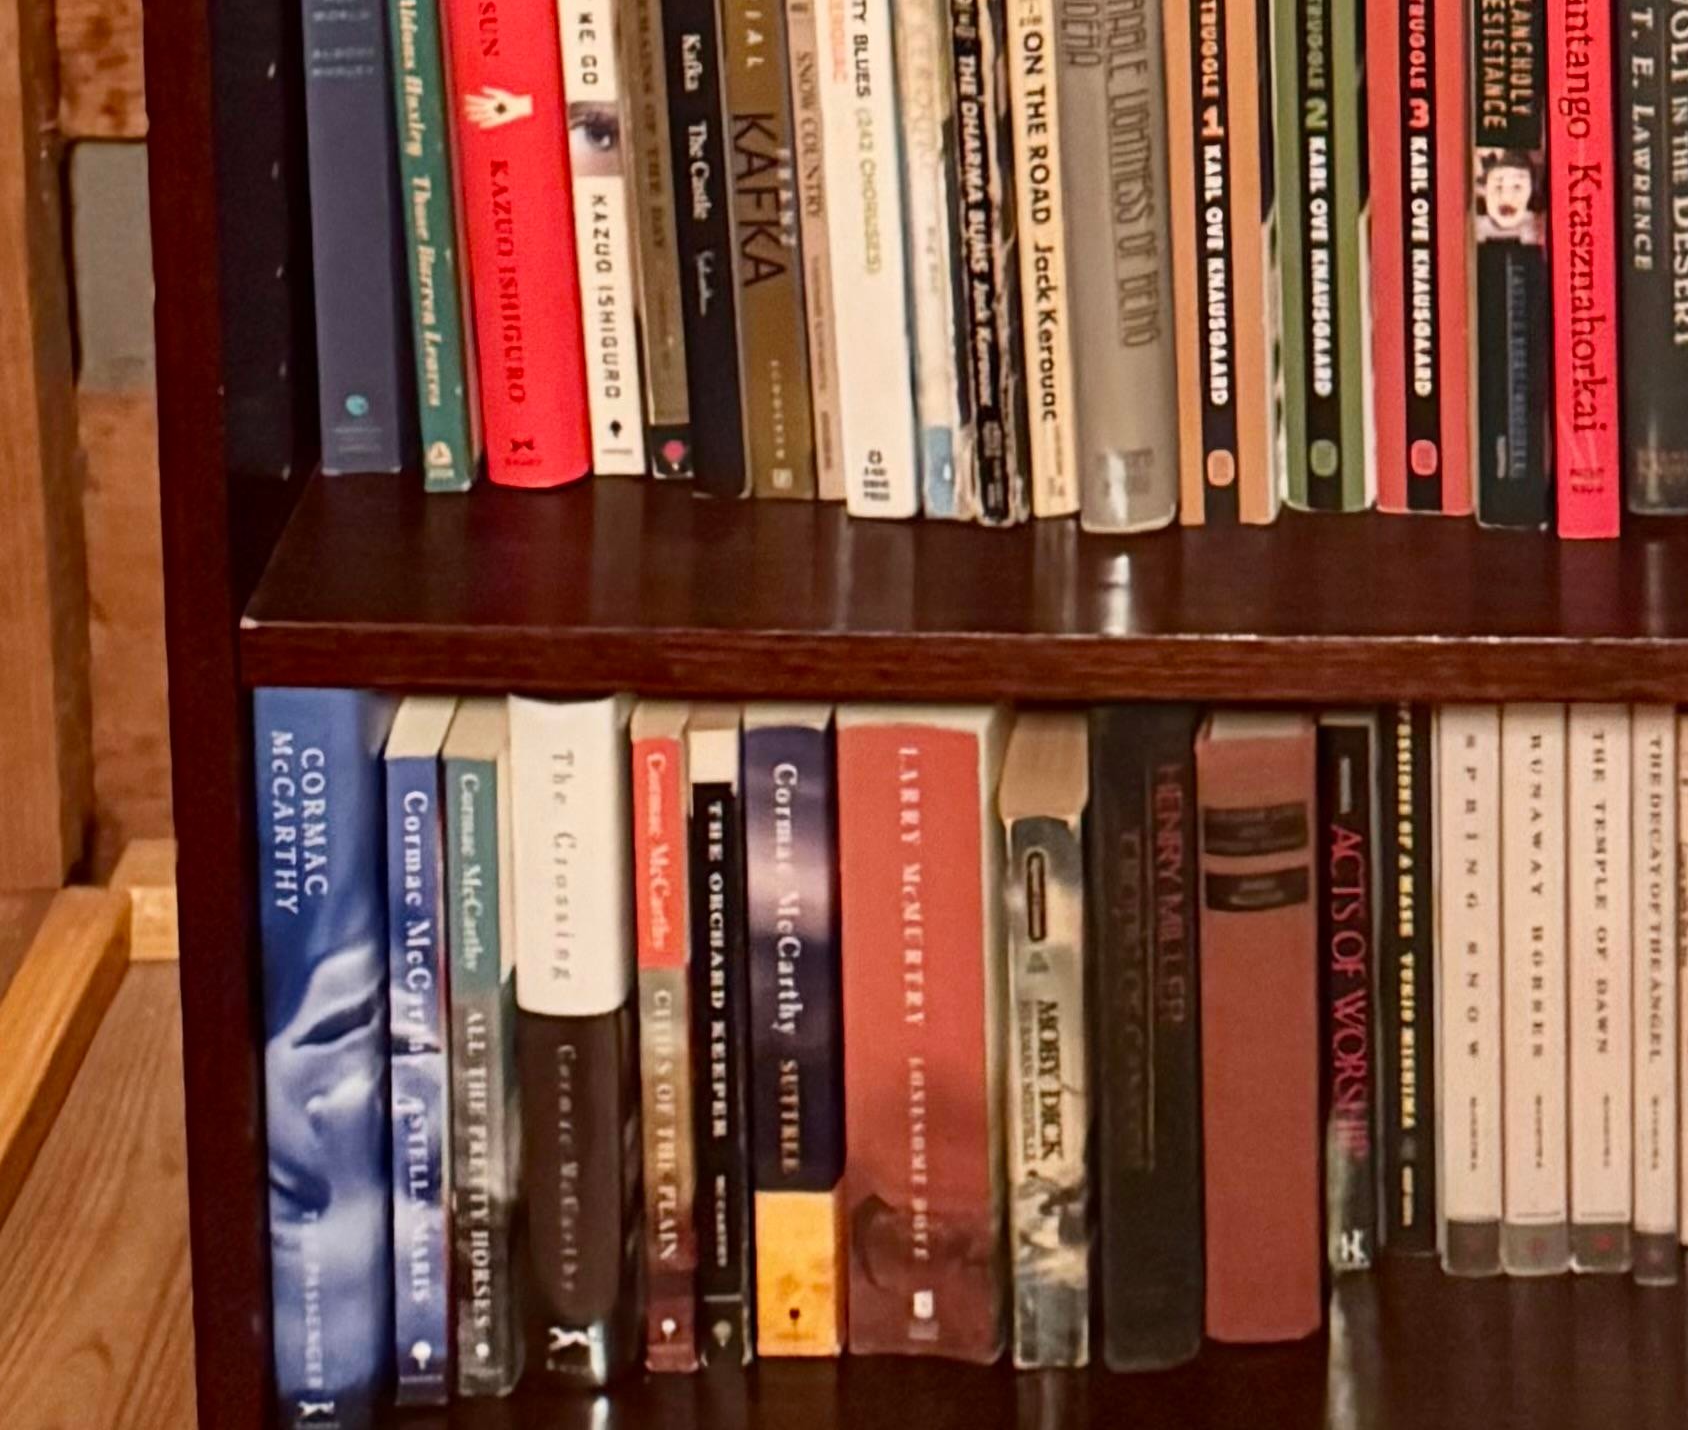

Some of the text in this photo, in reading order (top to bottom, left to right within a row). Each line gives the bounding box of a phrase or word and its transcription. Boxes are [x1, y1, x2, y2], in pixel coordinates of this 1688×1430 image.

[578, 13, 597, 44] ME
[583, 55, 598, 85] GO
[733, 112, 787, 287] KAFKA
[1632, 103, 1654, 271] LAWRENCE
[592, 195, 621, 400] KAZUO ISHIGURO
[1569, 161, 1604, 434] Krasznahorkai
[270, 730, 299, 916] McCARTHY
[300, 748, 328, 896] CORMAC
